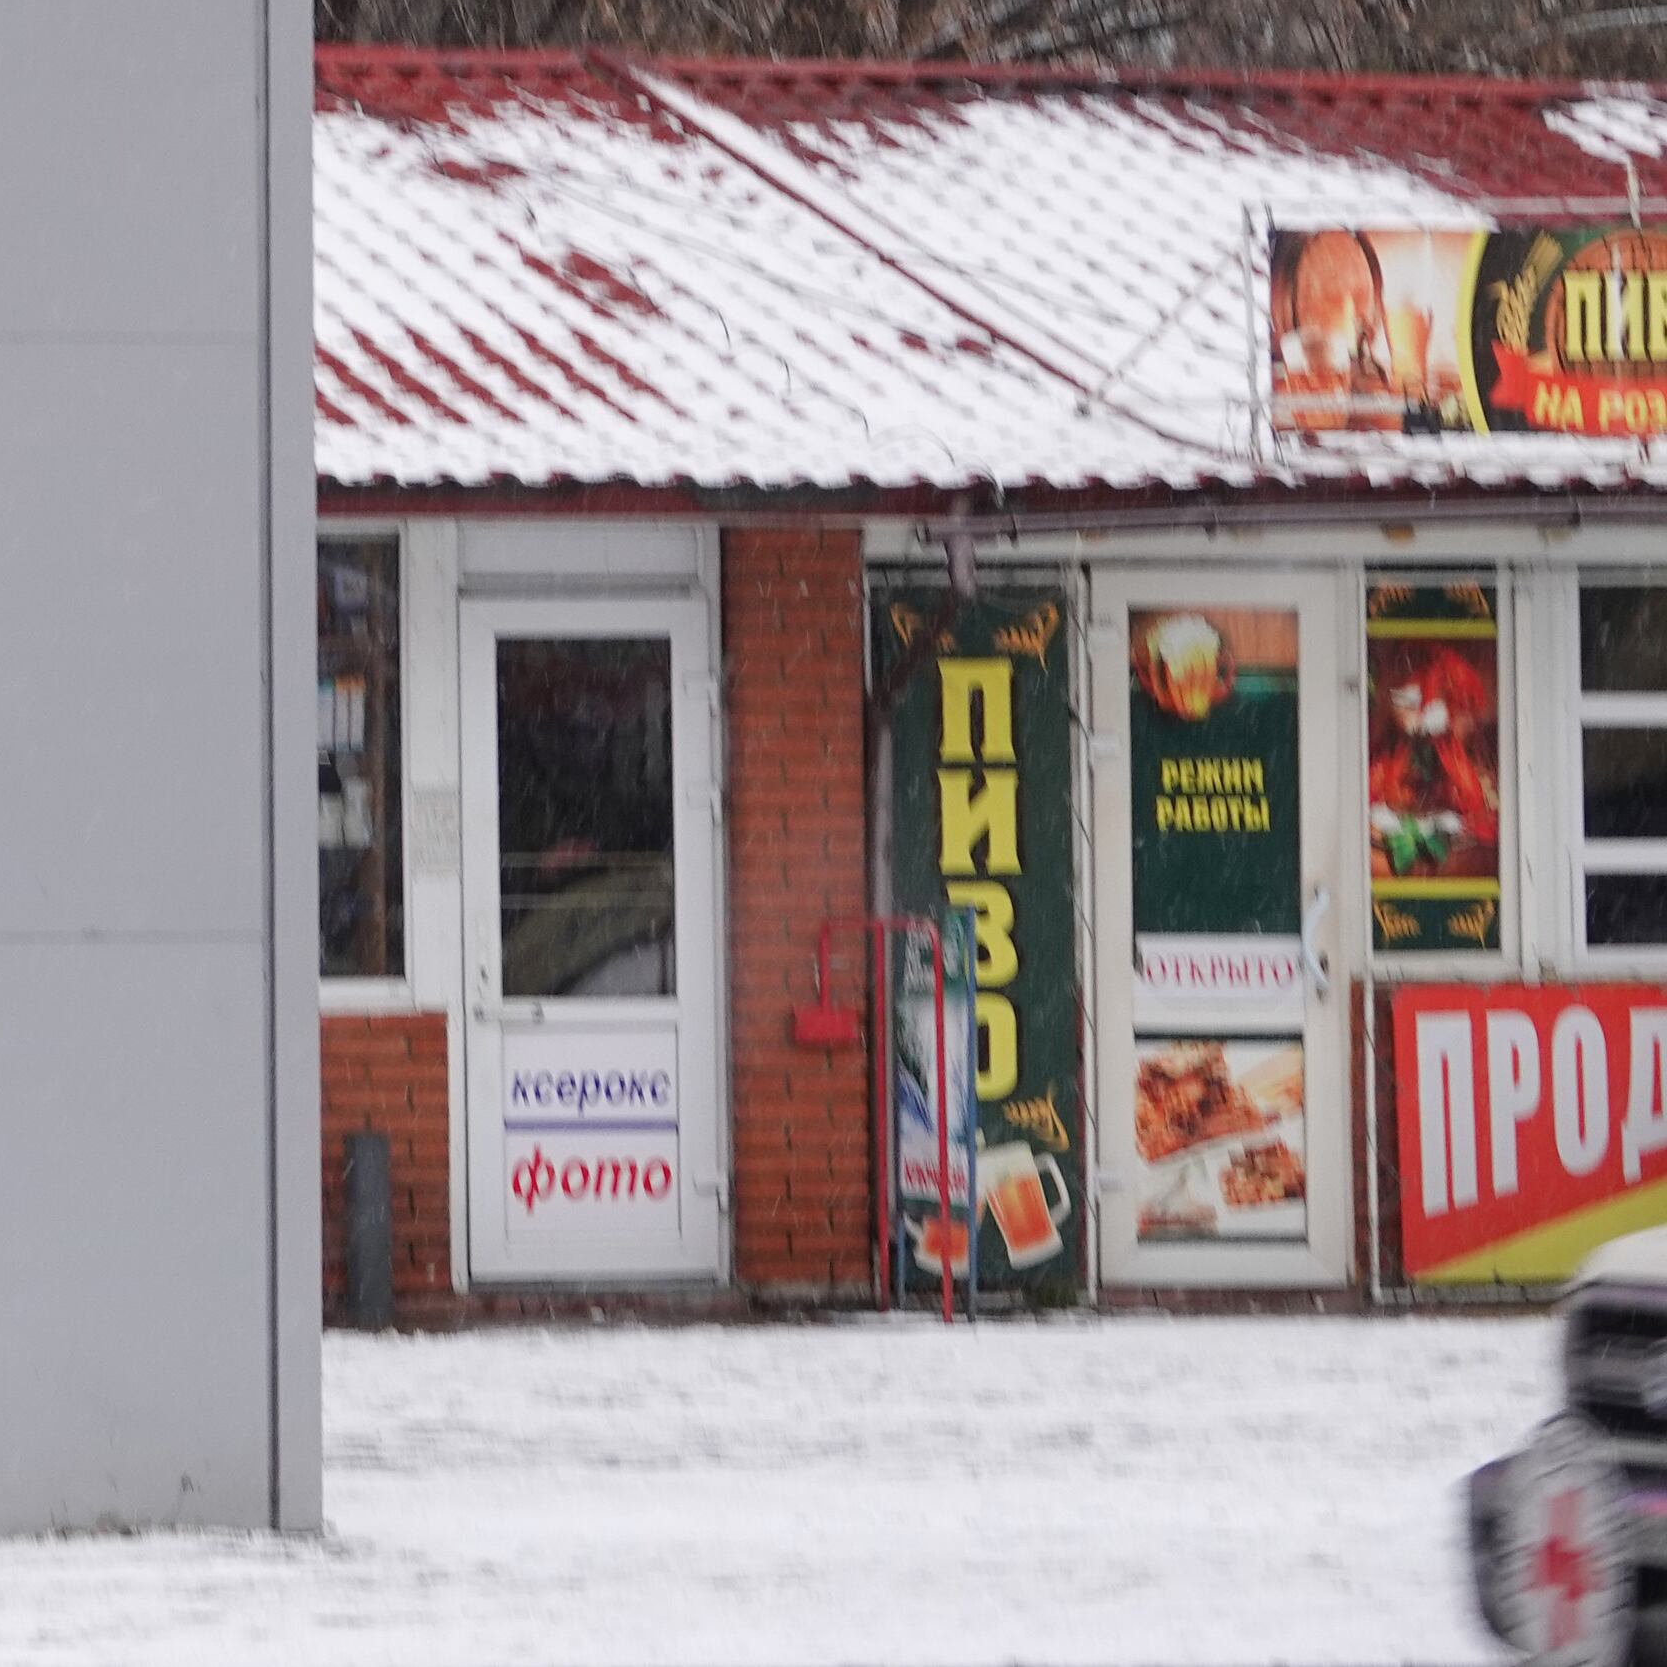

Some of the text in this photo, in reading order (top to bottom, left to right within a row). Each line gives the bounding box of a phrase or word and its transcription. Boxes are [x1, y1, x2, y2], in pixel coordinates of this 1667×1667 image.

[1534, 380, 1585, 432] НА
[1160, 757, 1265, 795] РЕЖИМ
[1155, 795, 1271, 833] РАБОТЫ
[936, 657, 1021, 1102] ПИВО
[1145, 954, 1297, 990] ОТКРЫТО
[510, 1067, 672, 1119] ксерокс
[510, 1144, 672, 1216] фото
